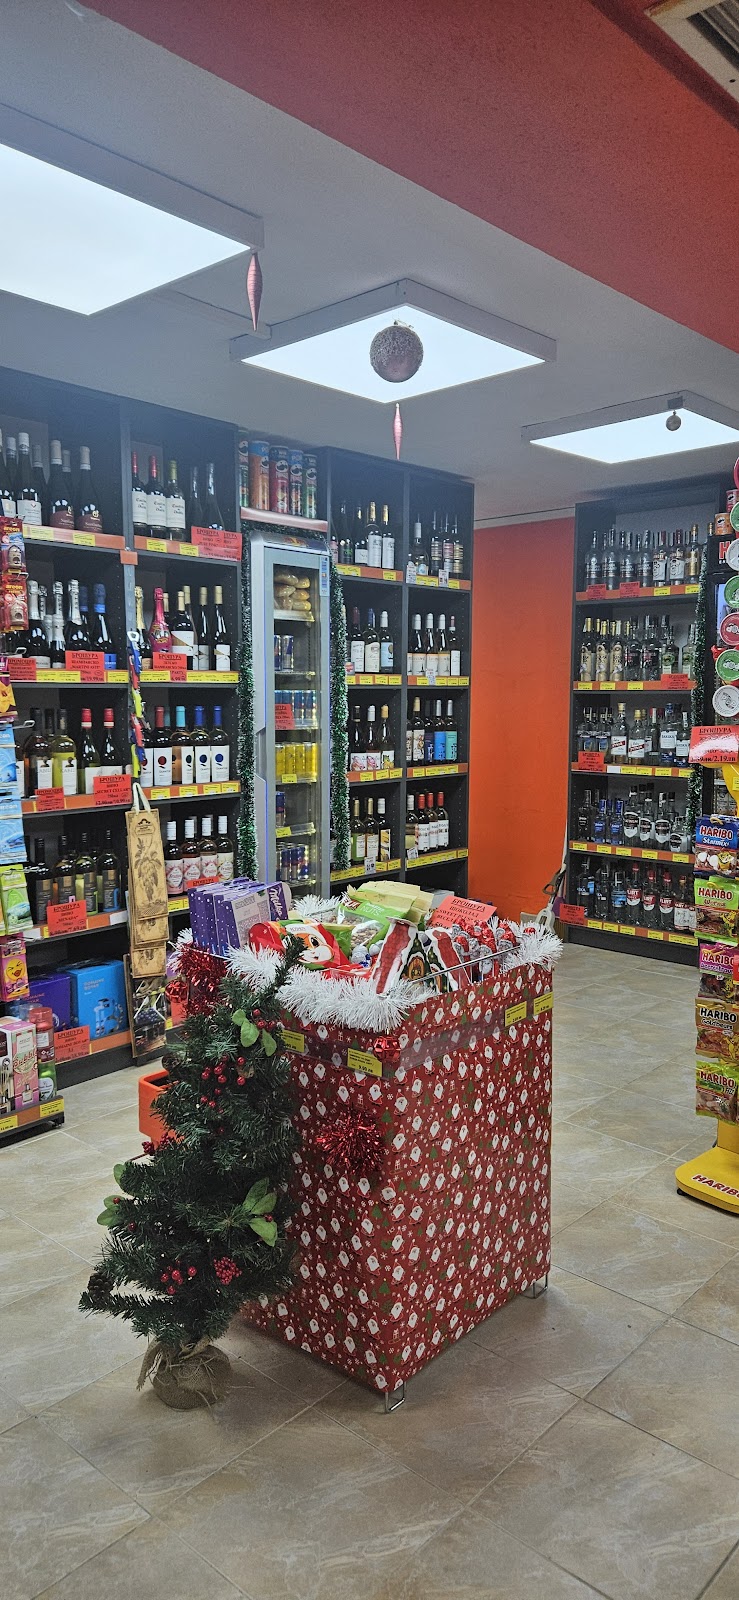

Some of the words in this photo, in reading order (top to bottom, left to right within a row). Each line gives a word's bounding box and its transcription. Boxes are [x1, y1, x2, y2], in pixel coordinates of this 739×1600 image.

[72, 652, 99, 660] БРОШУРА
[700, 825, 734, 841] HARIBO
[269, 887, 283, 918] Milka
[698, 887, 734, 902] HARIBO
[451, 898, 487, 913] БРОШУРА
[700, 1007, 737, 1023] HARIBO
[700, 1071, 736, 1088] HARIBO
[692, 1174, 739, 1199] HARIB
